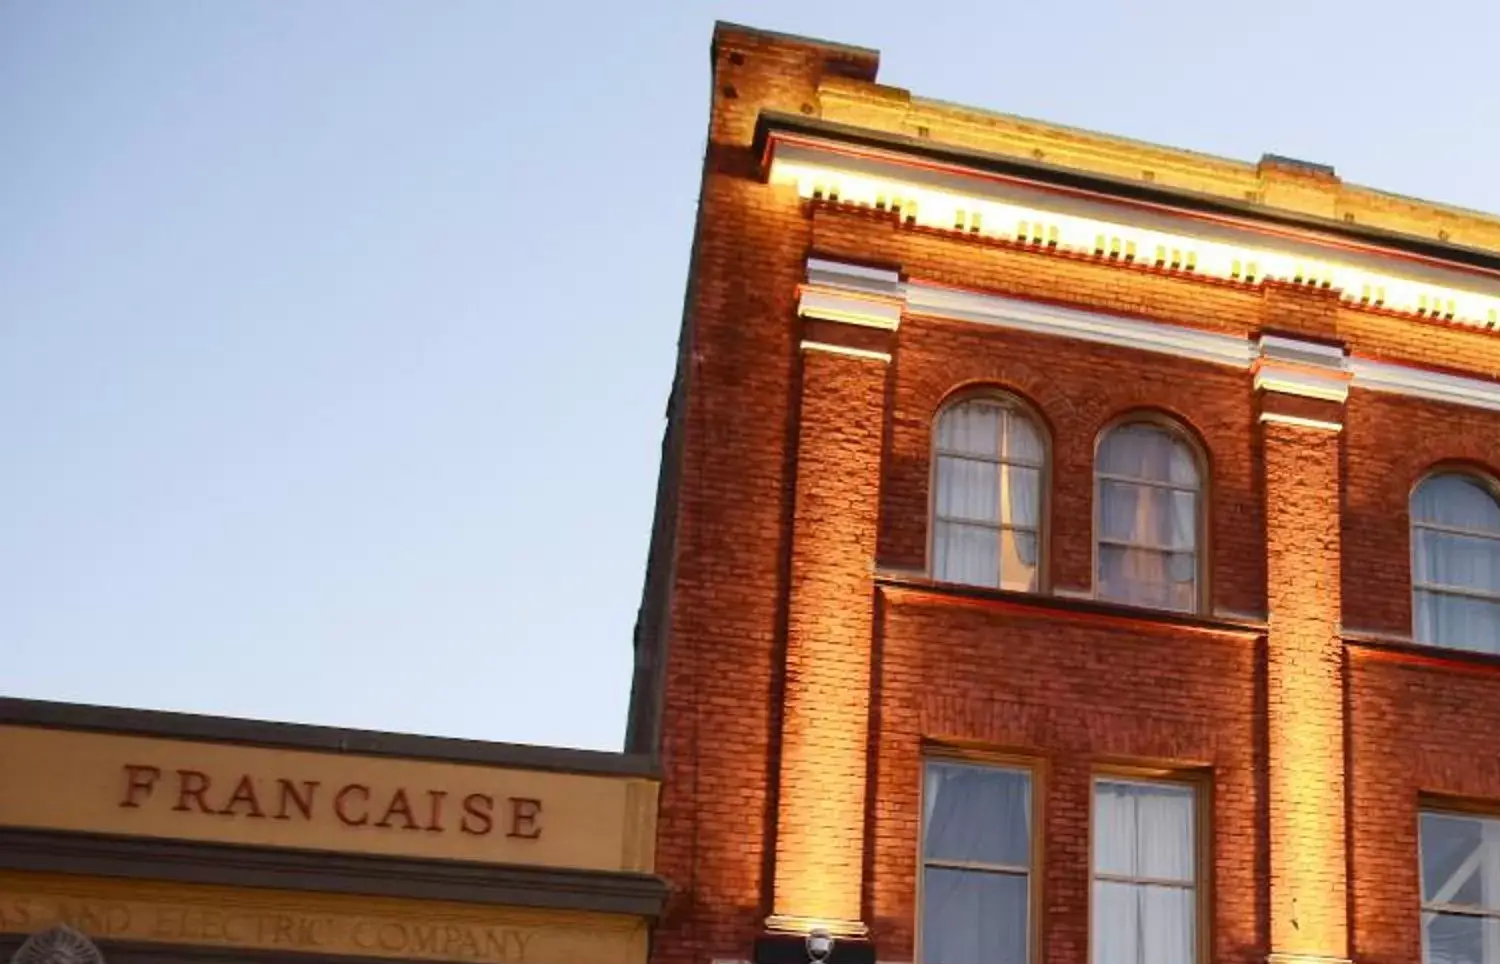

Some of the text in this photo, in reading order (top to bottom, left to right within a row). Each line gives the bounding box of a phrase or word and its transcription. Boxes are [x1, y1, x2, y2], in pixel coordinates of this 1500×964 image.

[118, 764, 543, 839] FRANCAISE
[155, 905, 336, 947] ELECTRIC
[352, 921, 540, 961] COMPANY
